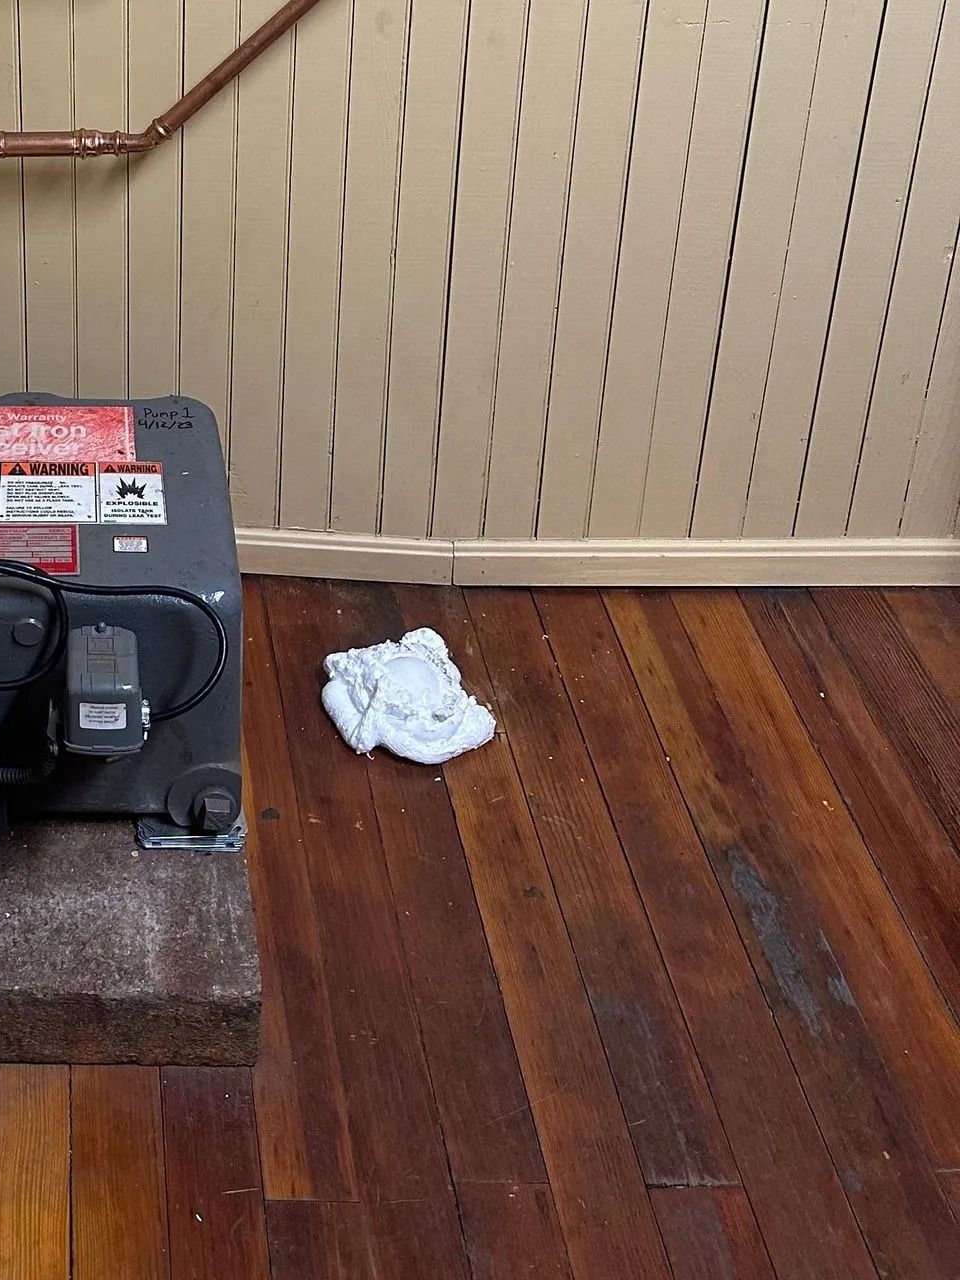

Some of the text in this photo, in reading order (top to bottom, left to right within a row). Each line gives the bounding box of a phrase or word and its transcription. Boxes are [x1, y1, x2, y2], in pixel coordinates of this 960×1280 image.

[6, 413, 67, 423] Warranty
[143, 406, 195, 420] Pump 1
[29, 462, 89, 476] WARNING
[117, 464, 157, 473] WARNING
